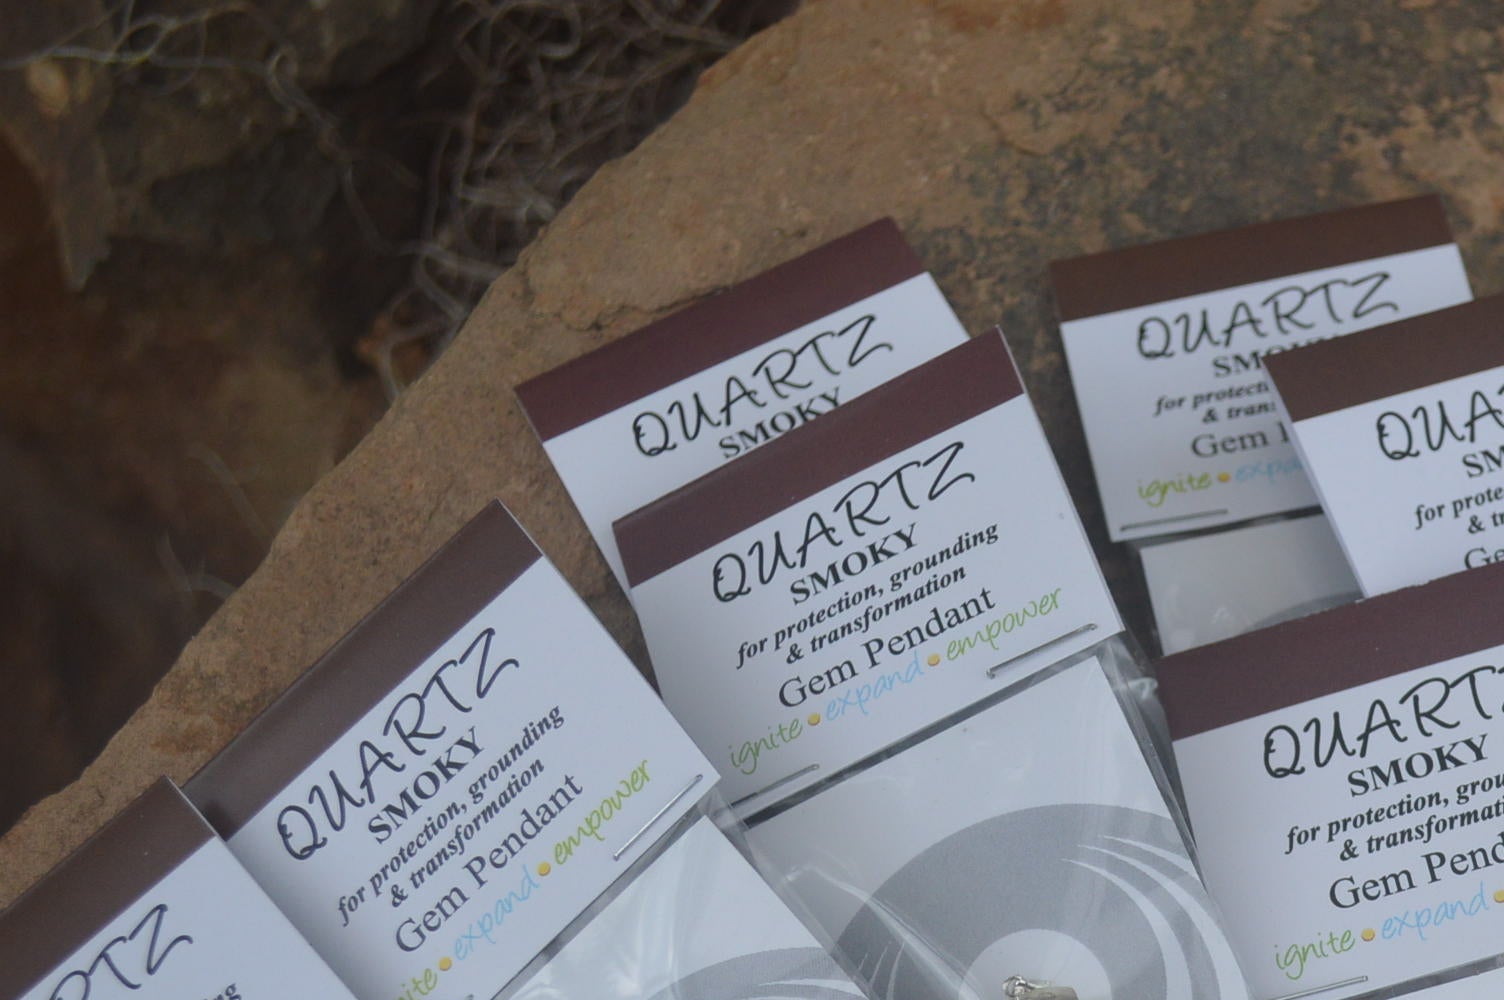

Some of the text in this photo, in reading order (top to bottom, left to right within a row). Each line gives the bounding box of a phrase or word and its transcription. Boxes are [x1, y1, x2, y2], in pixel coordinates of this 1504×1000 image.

[1137, 272, 1399, 360] QUARTZ
[632, 314, 894, 457] QUARTZ
[719, 386, 839, 458] SMOKY
[1153, 396, 1186, 417] for
[1192, 381, 1269, 411] protecti
[1202, 407, 1218, 425] &
[1137, 472, 1212, 508] ignite
[1190, 430, 1269, 458] Gem
[711, 442, 976, 602] QUARTZ
[1414, 501, 1446, 530] for
[1466, 512, 1487, 535] &
[735, 524, 1000, 669] for protection, grounding
[789, 523, 921, 606] SMOKY
[778, 587, 998, 709] Gem Pendant
[784, 567, 967, 666] & transformation
[727, 588, 1064, 776] ignite expand empower
[276, 627, 520, 861] QUARTZ
[367, 727, 485, 843] SMOKY
[1347, 734, 1490, 798] SMOKY
[337, 705, 565, 926] for protection, grounding
[389, 759, 545, 908] & transformation
[395, 772, 584, 952] Gem Pendant
[452, 867, 540, 960] expand
[552, 760, 652, 865] empower
[1284, 824, 1321, 854] for
[1326, 788, 1449, 844] protection,
[1338, 839, 1359, 862] &
[1274, 928, 1356, 981] ignite
[1381, 882, 1488, 941] expand
[1330, 867, 1417, 909] Gem
